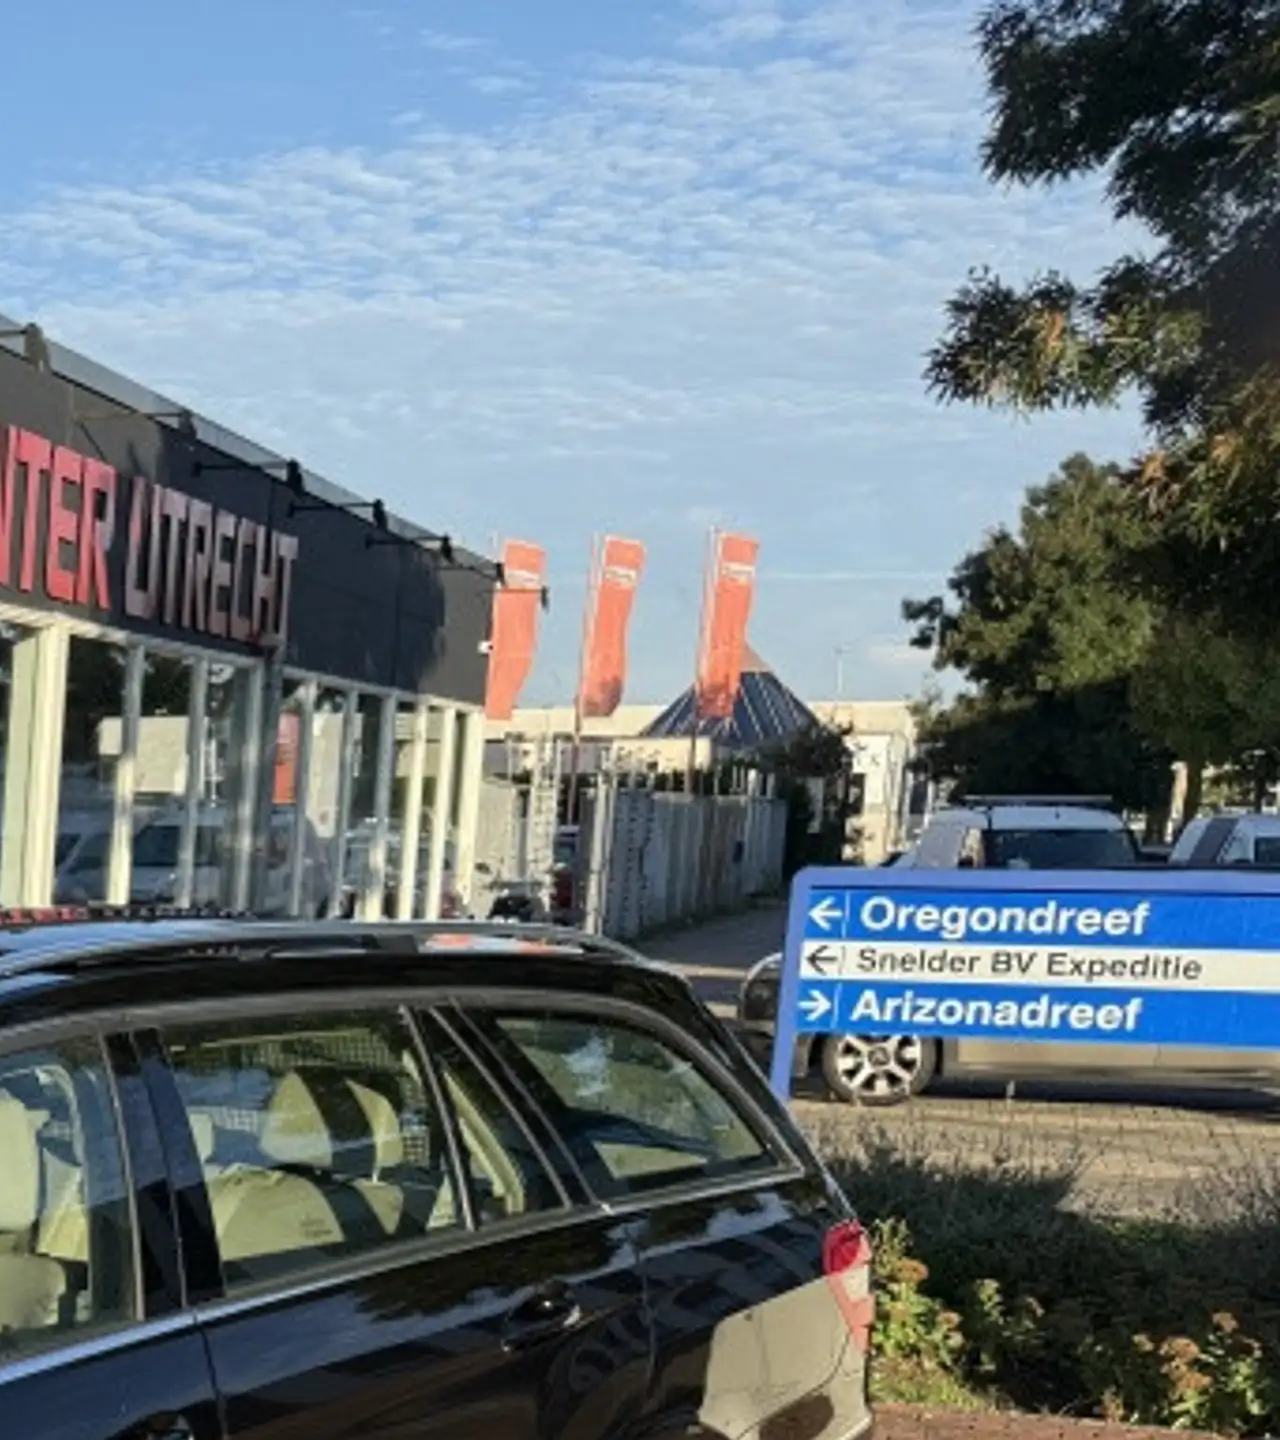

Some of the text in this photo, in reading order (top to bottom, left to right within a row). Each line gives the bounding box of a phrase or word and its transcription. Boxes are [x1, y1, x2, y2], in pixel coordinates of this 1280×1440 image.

[124, 475, 300, 645] UTRECHT
[860, 895, 1151, 940] Oregondreef
[856, 946, 1203, 983] Snelder BV Expeditie
[850, 988, 1144, 1031] Arizonadreef
